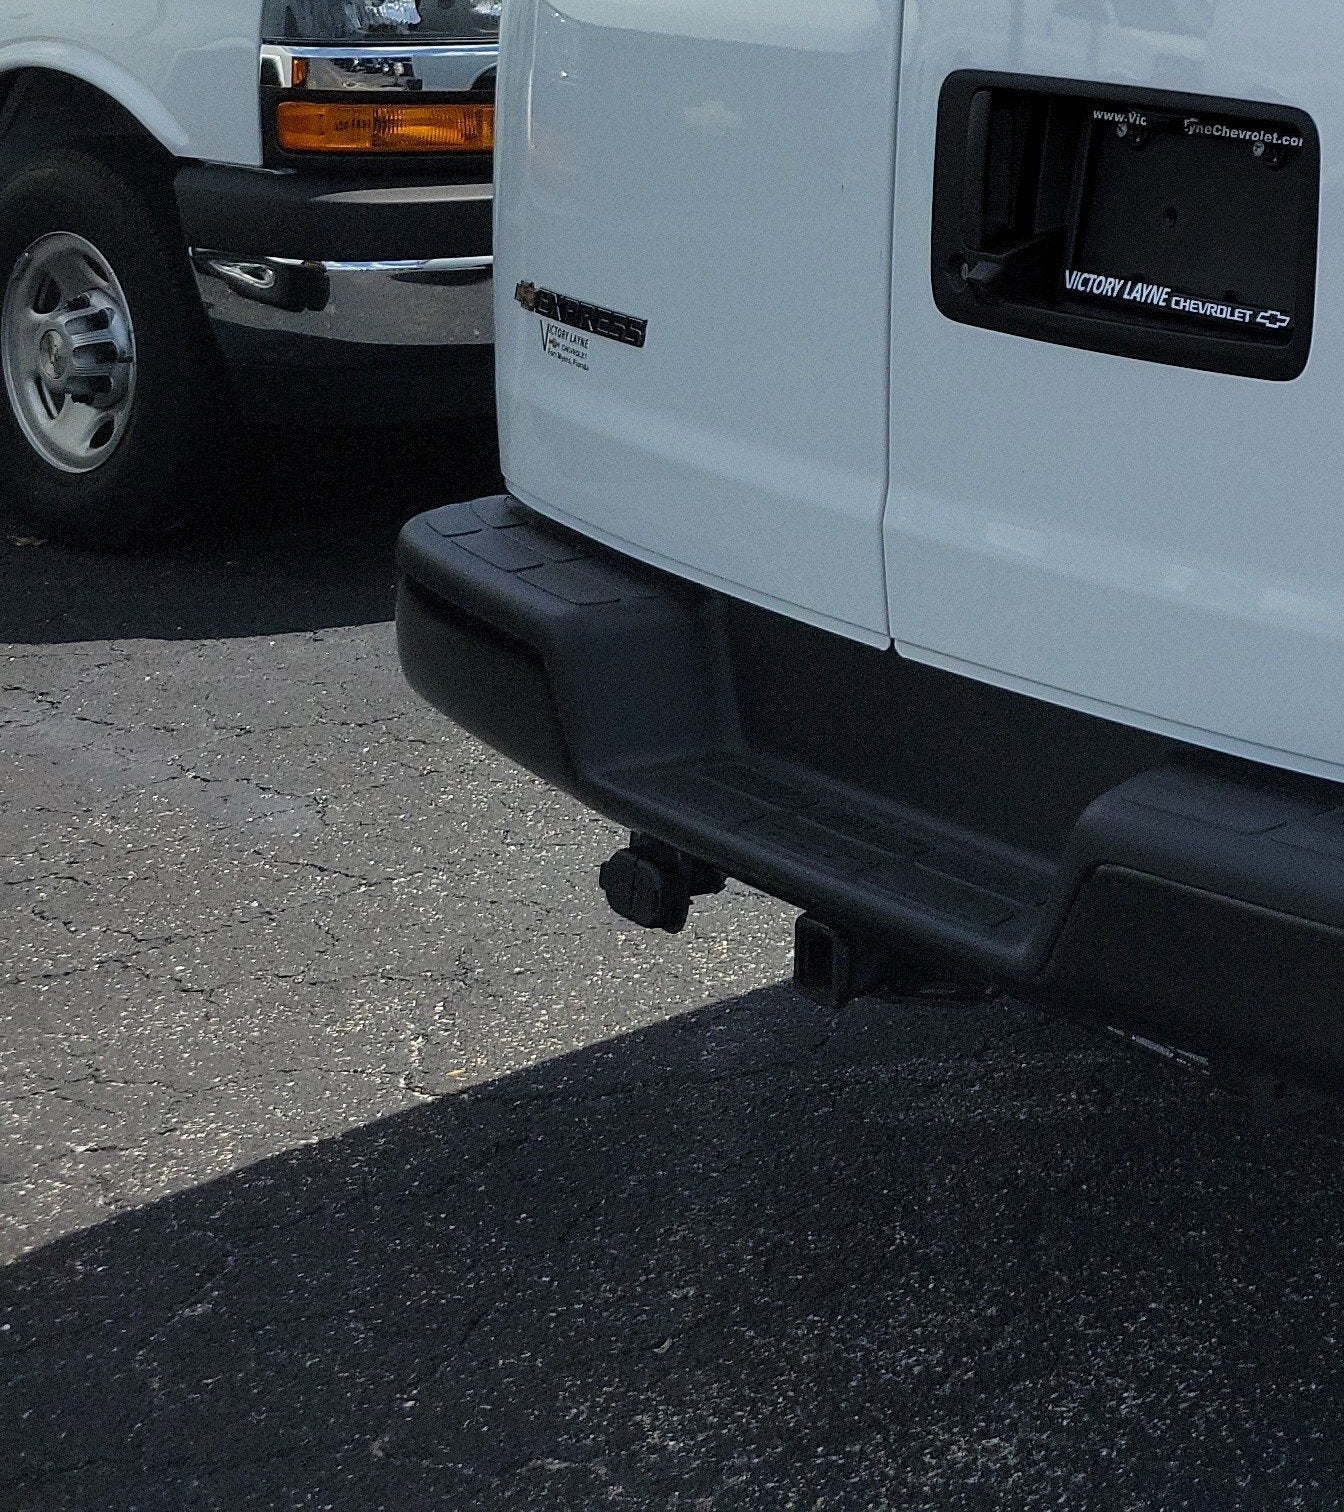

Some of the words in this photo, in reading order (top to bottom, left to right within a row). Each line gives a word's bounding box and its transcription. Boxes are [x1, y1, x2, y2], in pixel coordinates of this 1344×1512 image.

[534, 287, 648, 348] EXPRESS
[1065, 269, 1125, 298] VICTORY
[1123, 281, 1172, 306] LAYNE
[1171, 296, 1253, 323] CHEVROLET
[570, 333, 589, 349] LAYNE
